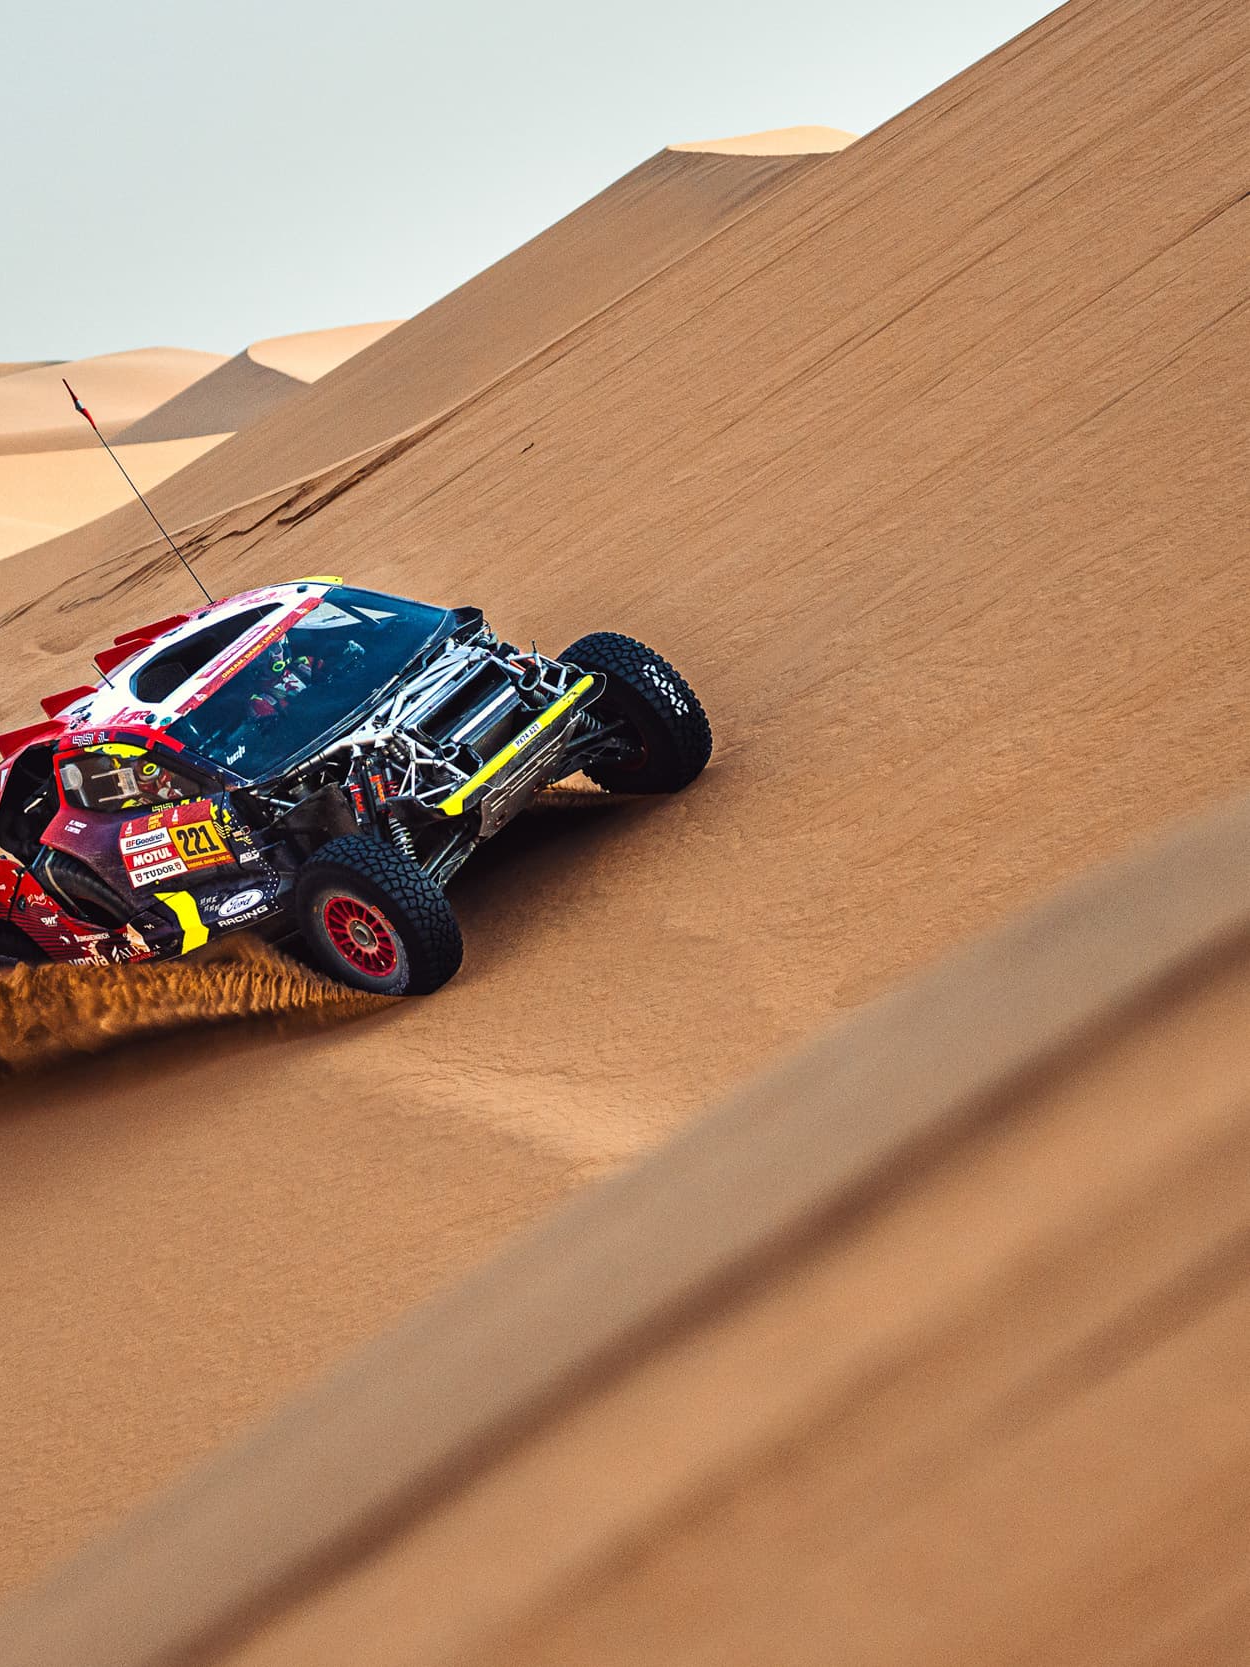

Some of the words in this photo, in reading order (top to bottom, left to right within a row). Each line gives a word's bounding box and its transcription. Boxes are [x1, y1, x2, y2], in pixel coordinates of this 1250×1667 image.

[125, 832, 165, 848] BFGoodrich
[176, 825, 220, 857] 221
[133, 847, 172, 868] MOTUL
[142, 864, 175, 880] TUDOR
[217, 904, 269, 928] RACING
